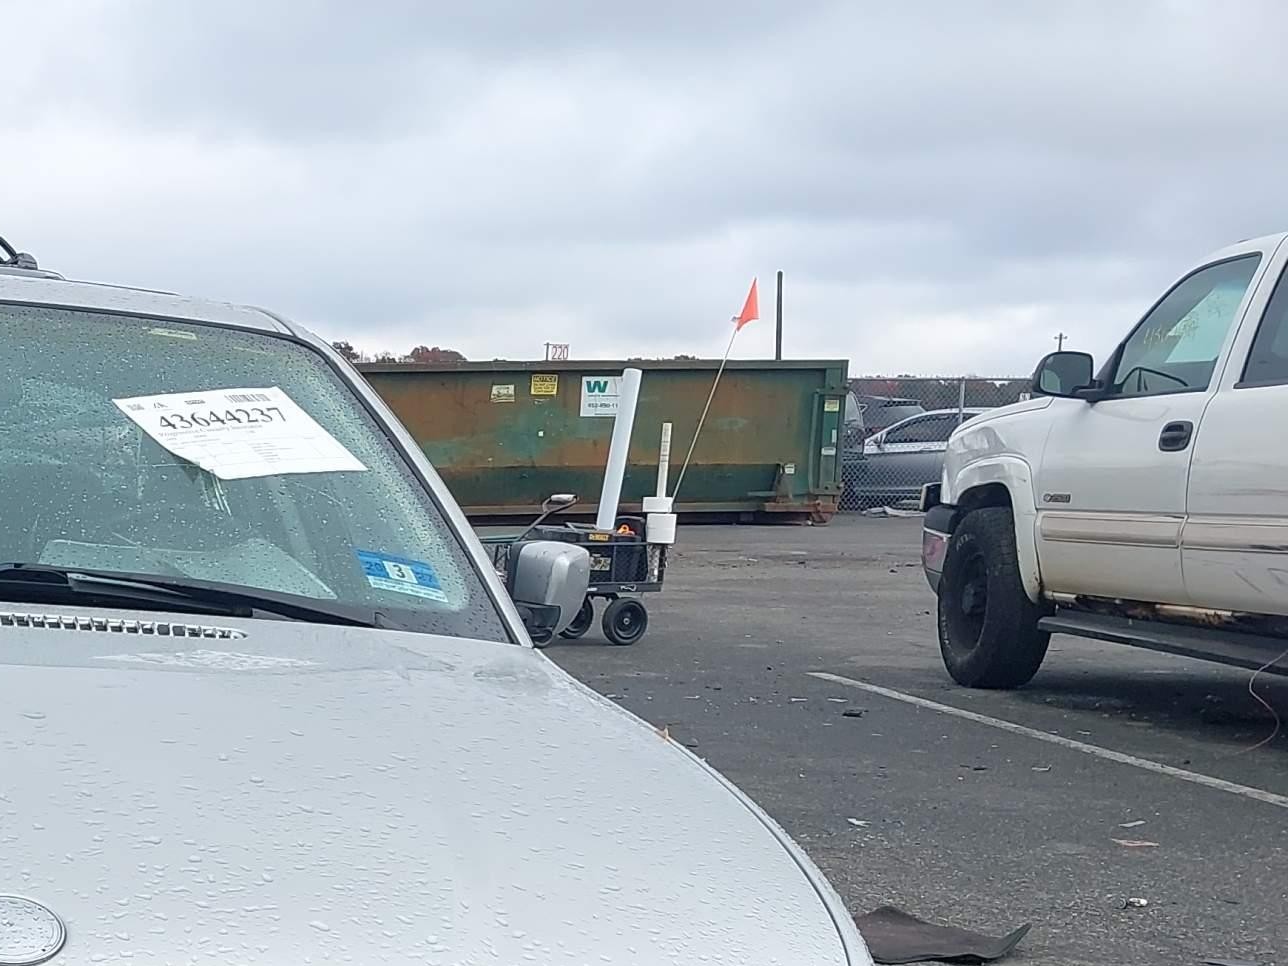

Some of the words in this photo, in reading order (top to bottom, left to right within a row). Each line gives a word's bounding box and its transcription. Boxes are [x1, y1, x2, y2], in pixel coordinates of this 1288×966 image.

[552, 345, 569, 360] 220
[159, 407, 286, 430] 43644237
[392, 564, 406, 579] 3
